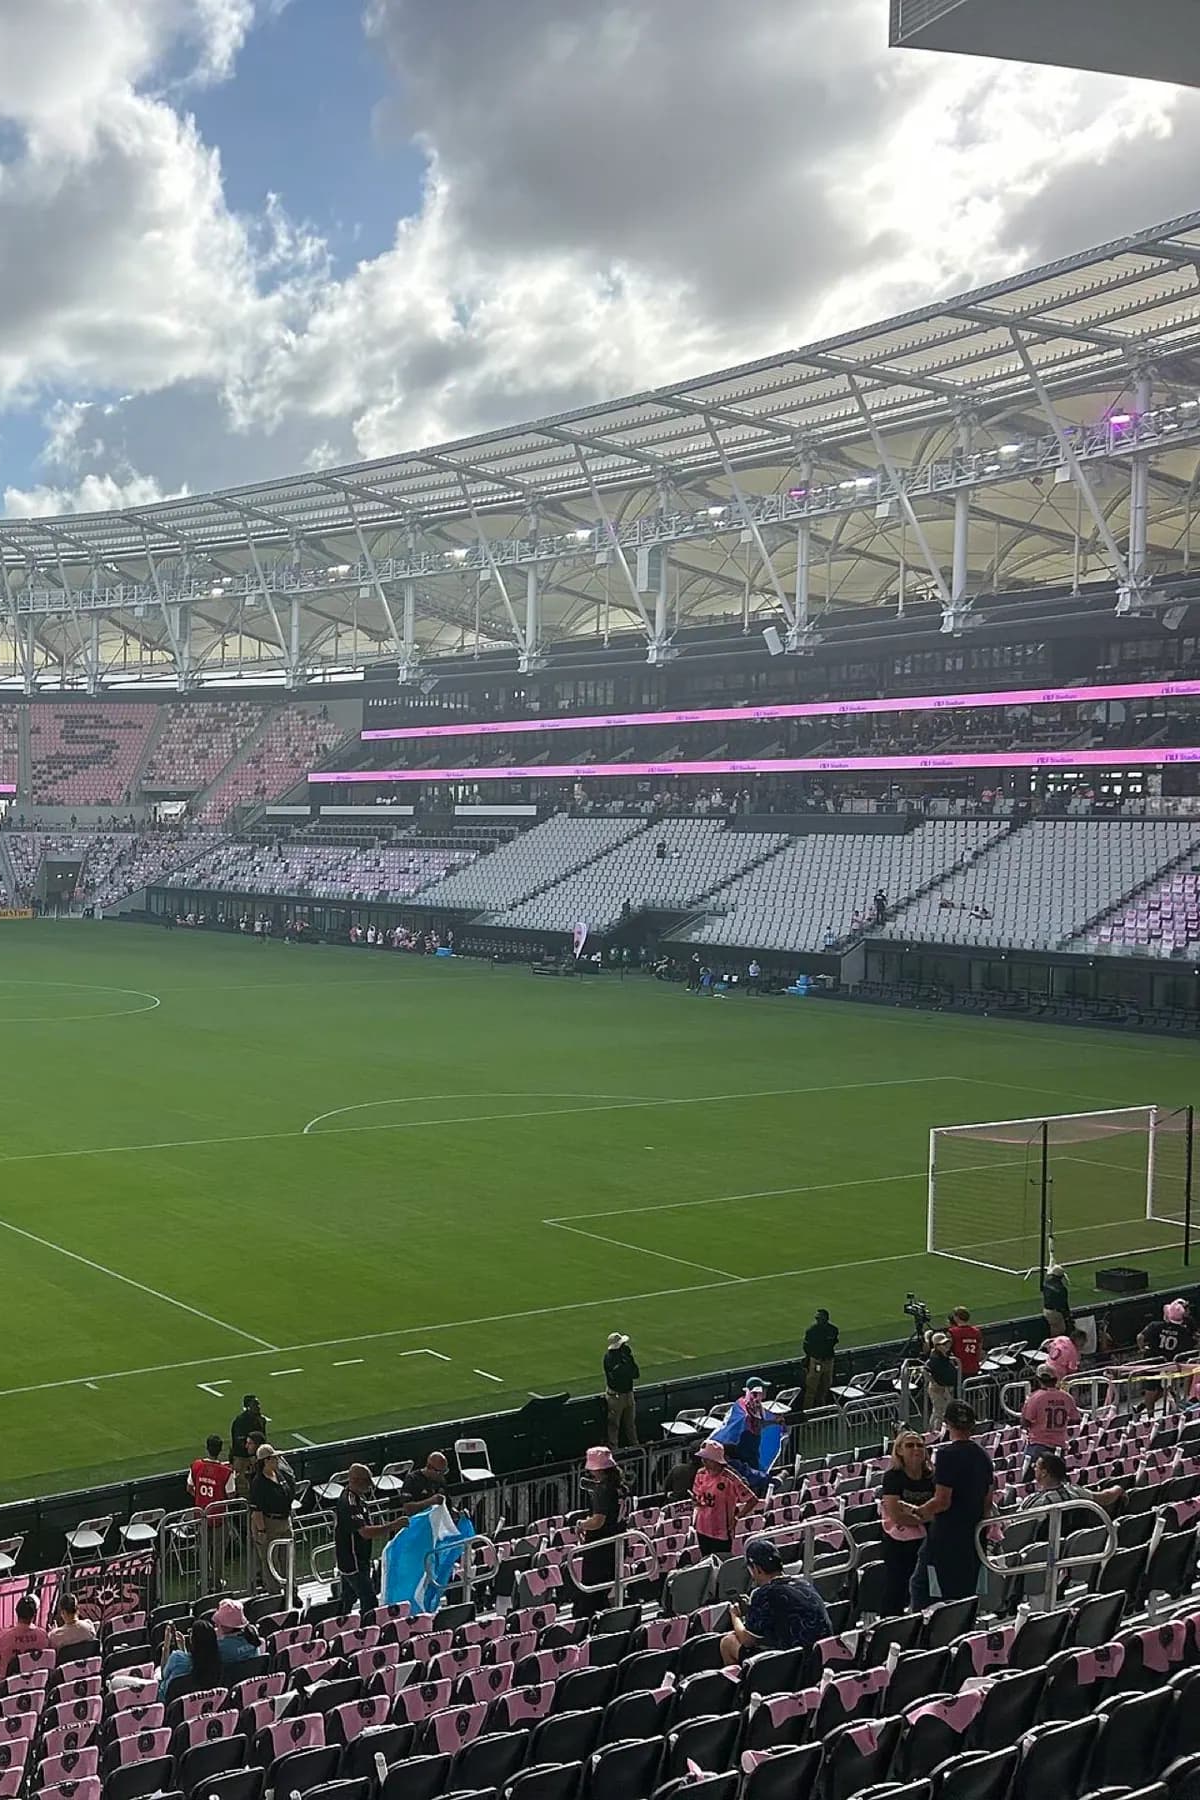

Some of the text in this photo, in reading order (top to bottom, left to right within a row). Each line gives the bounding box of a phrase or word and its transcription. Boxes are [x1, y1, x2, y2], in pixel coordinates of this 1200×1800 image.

[1159, 1333, 1179, 1351] 10
[1044, 1406, 1068, 1430] 10
[199, 1484, 214, 1498] 03
